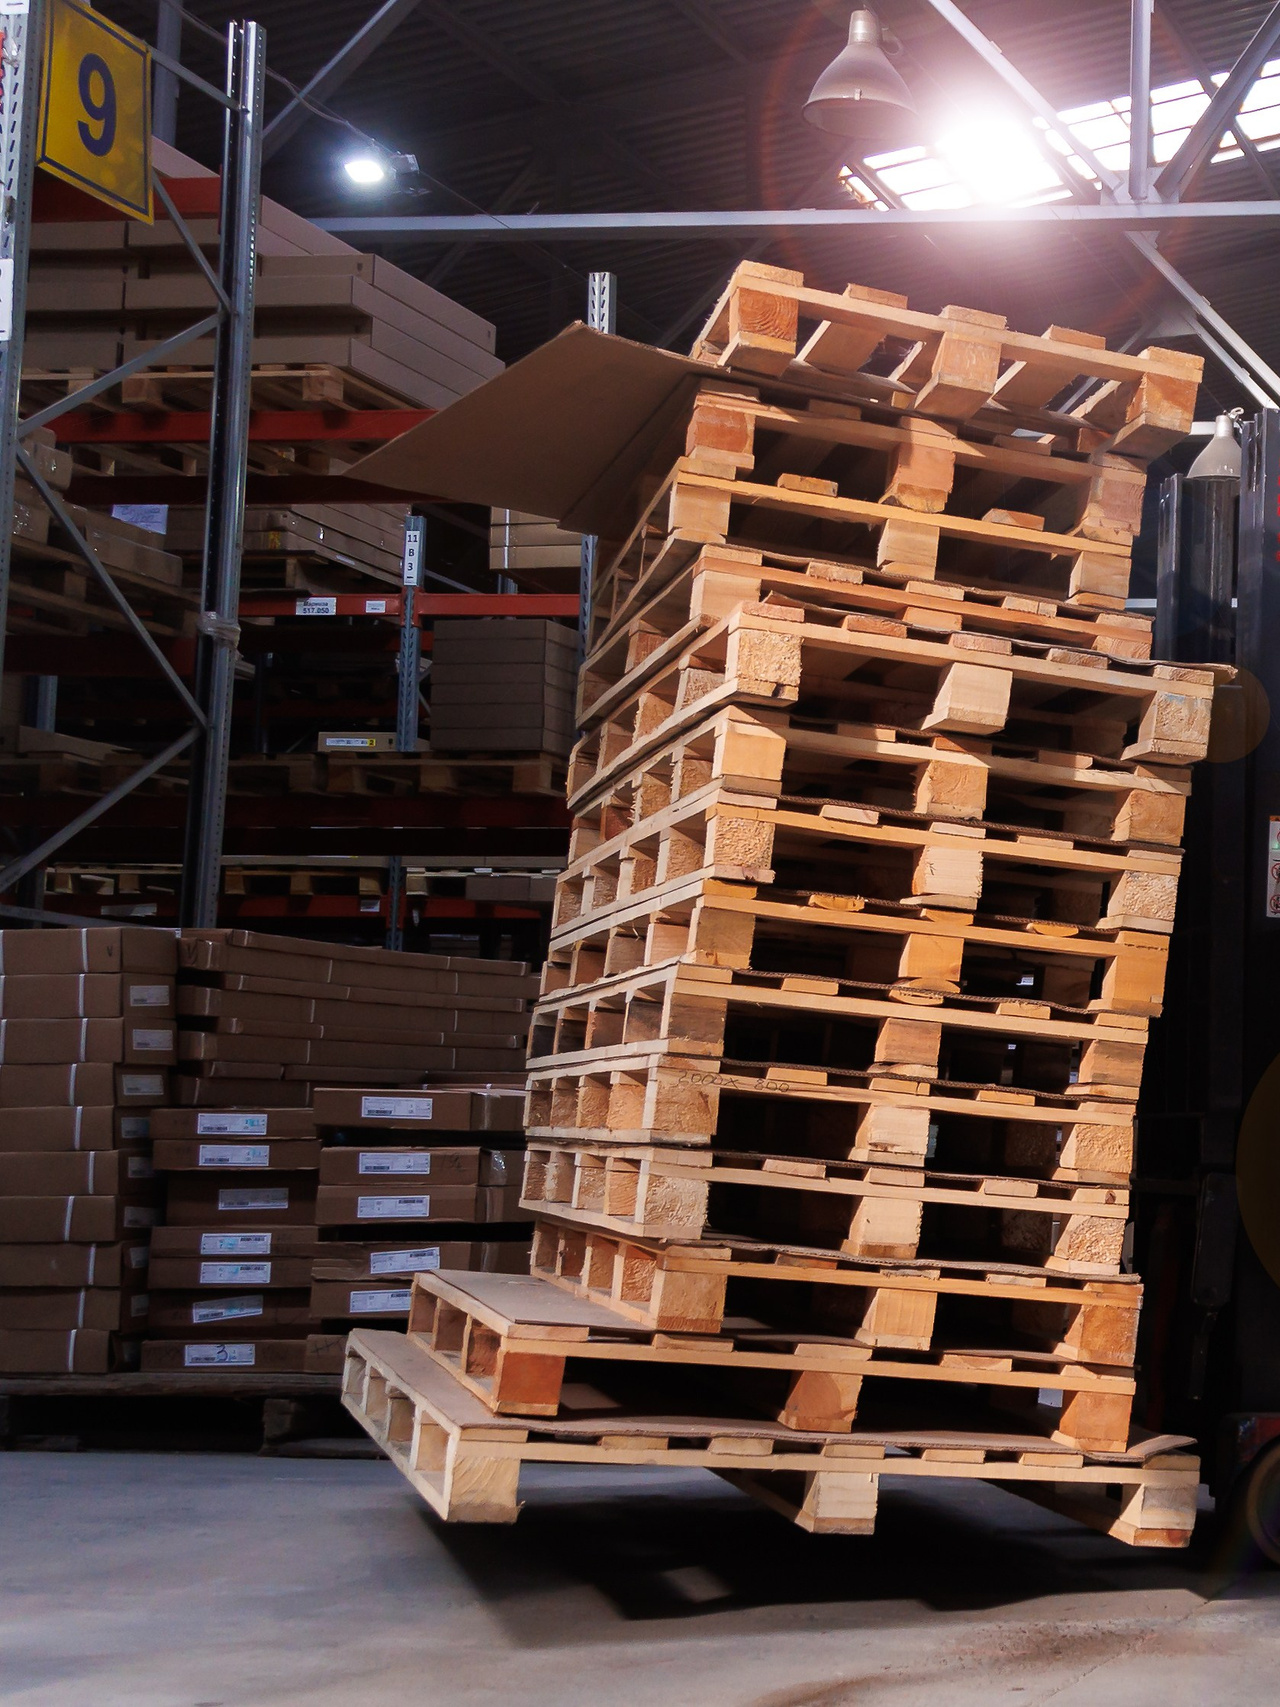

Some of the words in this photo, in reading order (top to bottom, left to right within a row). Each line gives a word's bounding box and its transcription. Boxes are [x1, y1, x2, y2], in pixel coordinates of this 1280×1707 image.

[78, 53, 116, 157] 9
[407, 534, 418, 543] 11
[408, 549, 415, 557] B
[407, 563, 414, 571] 3
